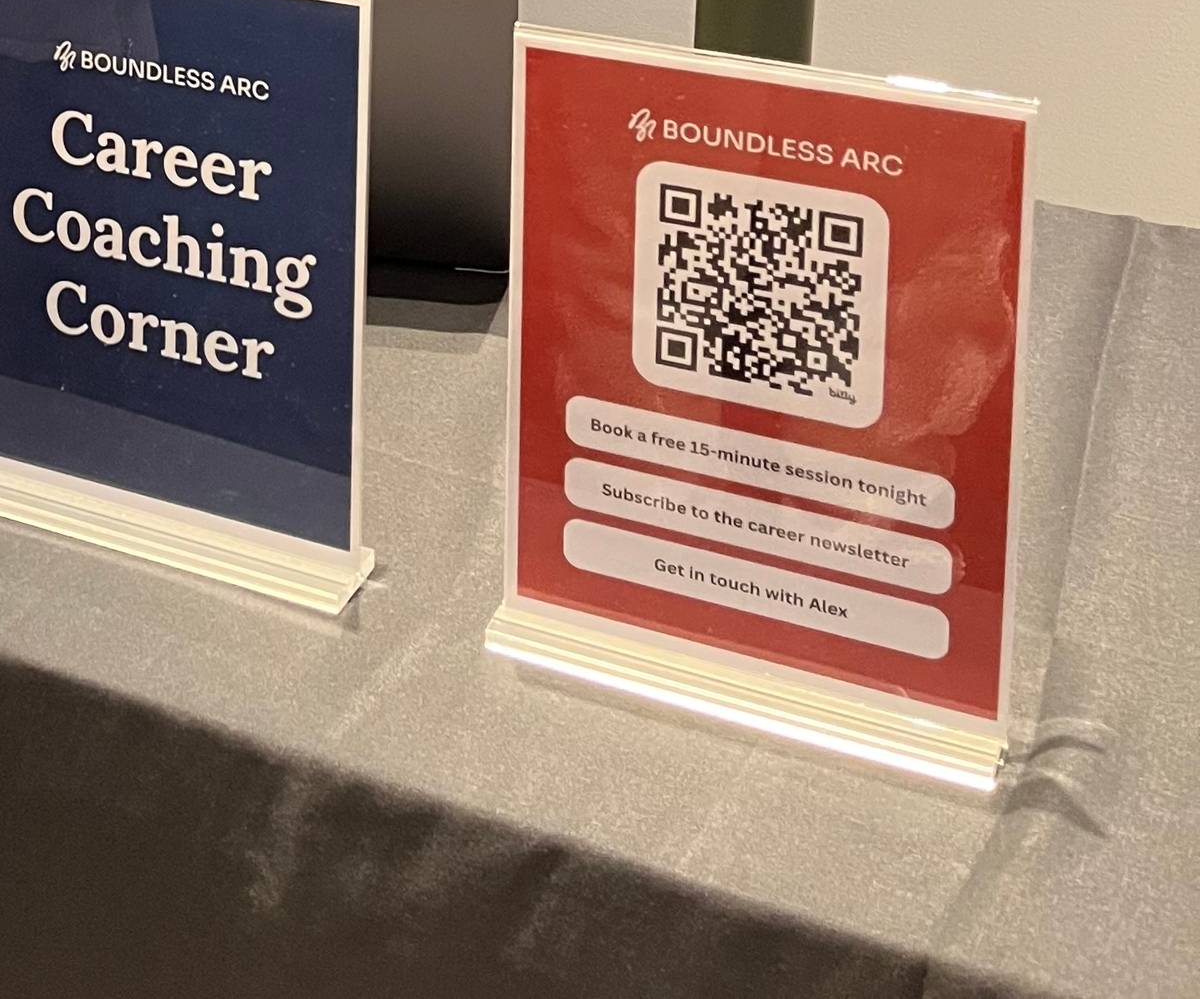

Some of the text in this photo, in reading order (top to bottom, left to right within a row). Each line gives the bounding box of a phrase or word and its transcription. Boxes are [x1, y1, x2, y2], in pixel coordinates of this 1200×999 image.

[80, 50, 270, 101] BOUNDLESS ARC
[51, 109, 273, 201] Career
[662, 119, 904, 177] BOUNDLESS ARC
[12, 187, 317, 320] Coaching
[46, 280, 275, 380] Corner
[591, 418, 928, 507] Book a free 15-minute session tonight
[602, 483, 910, 569] Subscribe to the career newsletter
[654, 558, 849, 619] Get in touch with Alex
